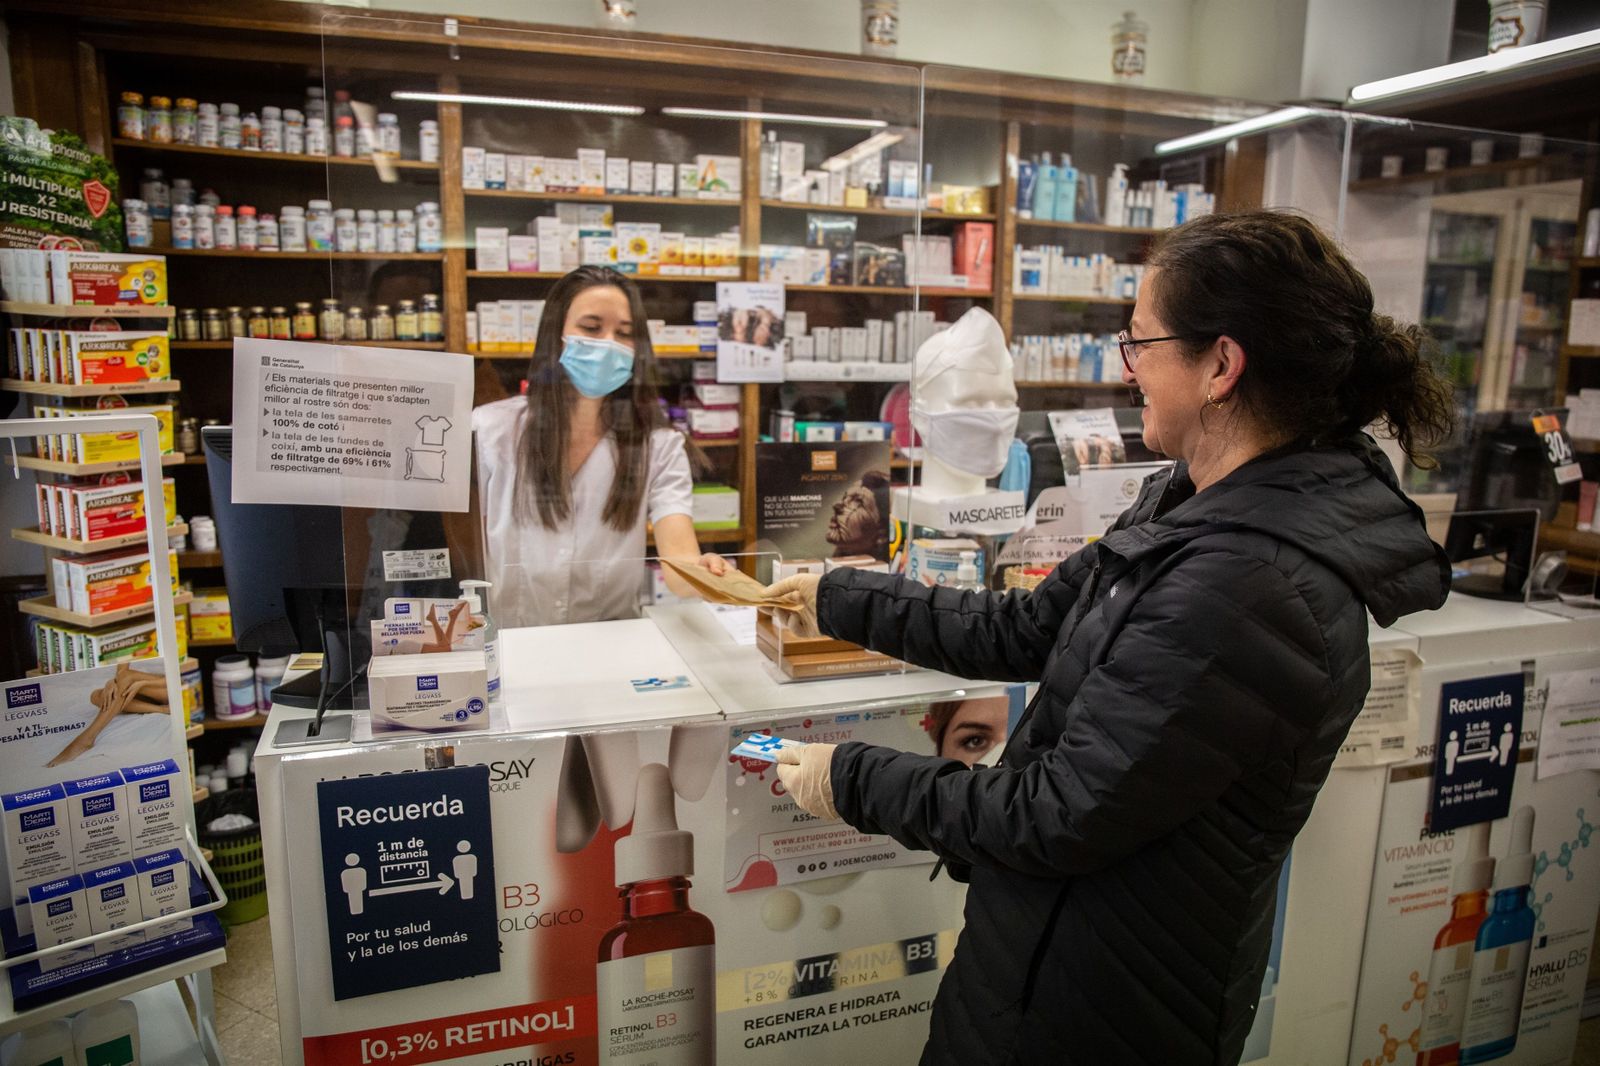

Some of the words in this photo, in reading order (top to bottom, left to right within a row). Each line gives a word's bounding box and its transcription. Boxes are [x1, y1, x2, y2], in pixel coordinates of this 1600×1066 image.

[49, 196, 57, 207] 2
[10, 202, 92, 230] RESISTENCIA!
[272, 373, 286, 383] Els
[289, 375, 330, 386] materials
[333, 379, 350, 390] que
[352, 381, 397, 392] presenten
[400, 384, 424, 394] millor
[264, 384, 308, 396] eficiència
[311, 387, 323, 396] de
[326, 388, 360, 401] filtratge
[367, 392, 384, 402] que
[386, 393, 430, 406] s'adapten
[264, 395, 290, 405] millor
[293, 396, 301, 405] al
[304, 398, 330, 407] rostre
[333, 399, 350, 409] són
[352, 401, 372, 411] dos:
[272, 407, 281, 416] la
[284, 408, 304, 418] tela
[306, 410, 318, 419] de
[321, 412, 335, 420] les
[338, 414, 392, 425] samarretes
[272, 418, 299, 428] 100%
[302, 420, 315, 429] de
[318, 420, 339, 431] cotó
[272, 431, 281, 440] la
[283, 432, 302, 442] tela
[305, 434, 317, 442] de
[320, 434, 334, 444] les
[336, 436, 369, 446] fundes
[372, 438, 384, 448] de
[271, 442, 298, 452] coixí,
[301, 444, 322, 452] amb
[325, 446, 343, 455] una
[345, 446, 392, 458] eficiència
[271, 452, 283, 461] de
[286, 453, 325, 465] filtratge
[328, 456, 340, 464] de
[342, 456, 363, 466] 69%
[371, 458, 392, 468] 61%
[270, 464, 343, 476] respectivament.
[1036, 503, 1064, 517] erin
[1449, 690, 1512, 715] Recuerda
[5, 708, 48, 722] LEGVASS
[0, 734, 25, 744] ESAN
[27, 730, 43, 739] LAS
[45, 722, 86, 735] PIERNAS?
[823, 730, 853, 741] ESTAT
[1441, 786, 1452, 794] Por
[1463, 779, 1482, 790] salud
[1454, 795, 1462, 803] de
[1464, 793, 1474, 801] los
[138, 801, 175, 814] LEGVASS
[337, 794, 464, 828] Recuerda
[81, 815, 120, 829] LEGVASS
[18, 829, 60, 844] LEGVASS
[377, 841, 386, 852] 1
[390, 840, 403, 850] m
[407, 837, 424, 849] de
[379, 848, 429, 862] distancia
[783, 844, 815, 853] TRUCANT
[503, 883, 540, 909] B3
[347, 931, 370, 944] Por
[374, 928, 390, 940] tu
[394, 920, 431, 937] salud
[348, 950, 357, 962] y
[361, 945, 373, 958] la
[377, 943, 395, 955] de
[399, 940, 419, 952] los
[424, 931, 468, 948] demás
[794, 950, 902, 983] VITAMINA
[906, 934, 937, 961] B3]
[1530, 960, 1566, 978] HYALU
[1568, 948, 1588, 968] B5
[622, 999, 633, 1007] LA
[636, 987, 695, 1004] ROCHE-POSAY
[744, 1007, 826, 1031] REGENERA
[828, 1002, 837, 1014] E
[840, 990, 901, 1012] HIDRATA
[610, 1022, 654, 1036] RETINOL
[656, 1012, 677, 1028] B3
[360, 1031, 439, 1064] [0,3%
[444, 1005, 575, 1047] RETINOL]
[610, 1032, 644, 1045] SERUM
[744, 1025, 829, 1049] GARANTIZA
[833, 1020, 850, 1031] LA
